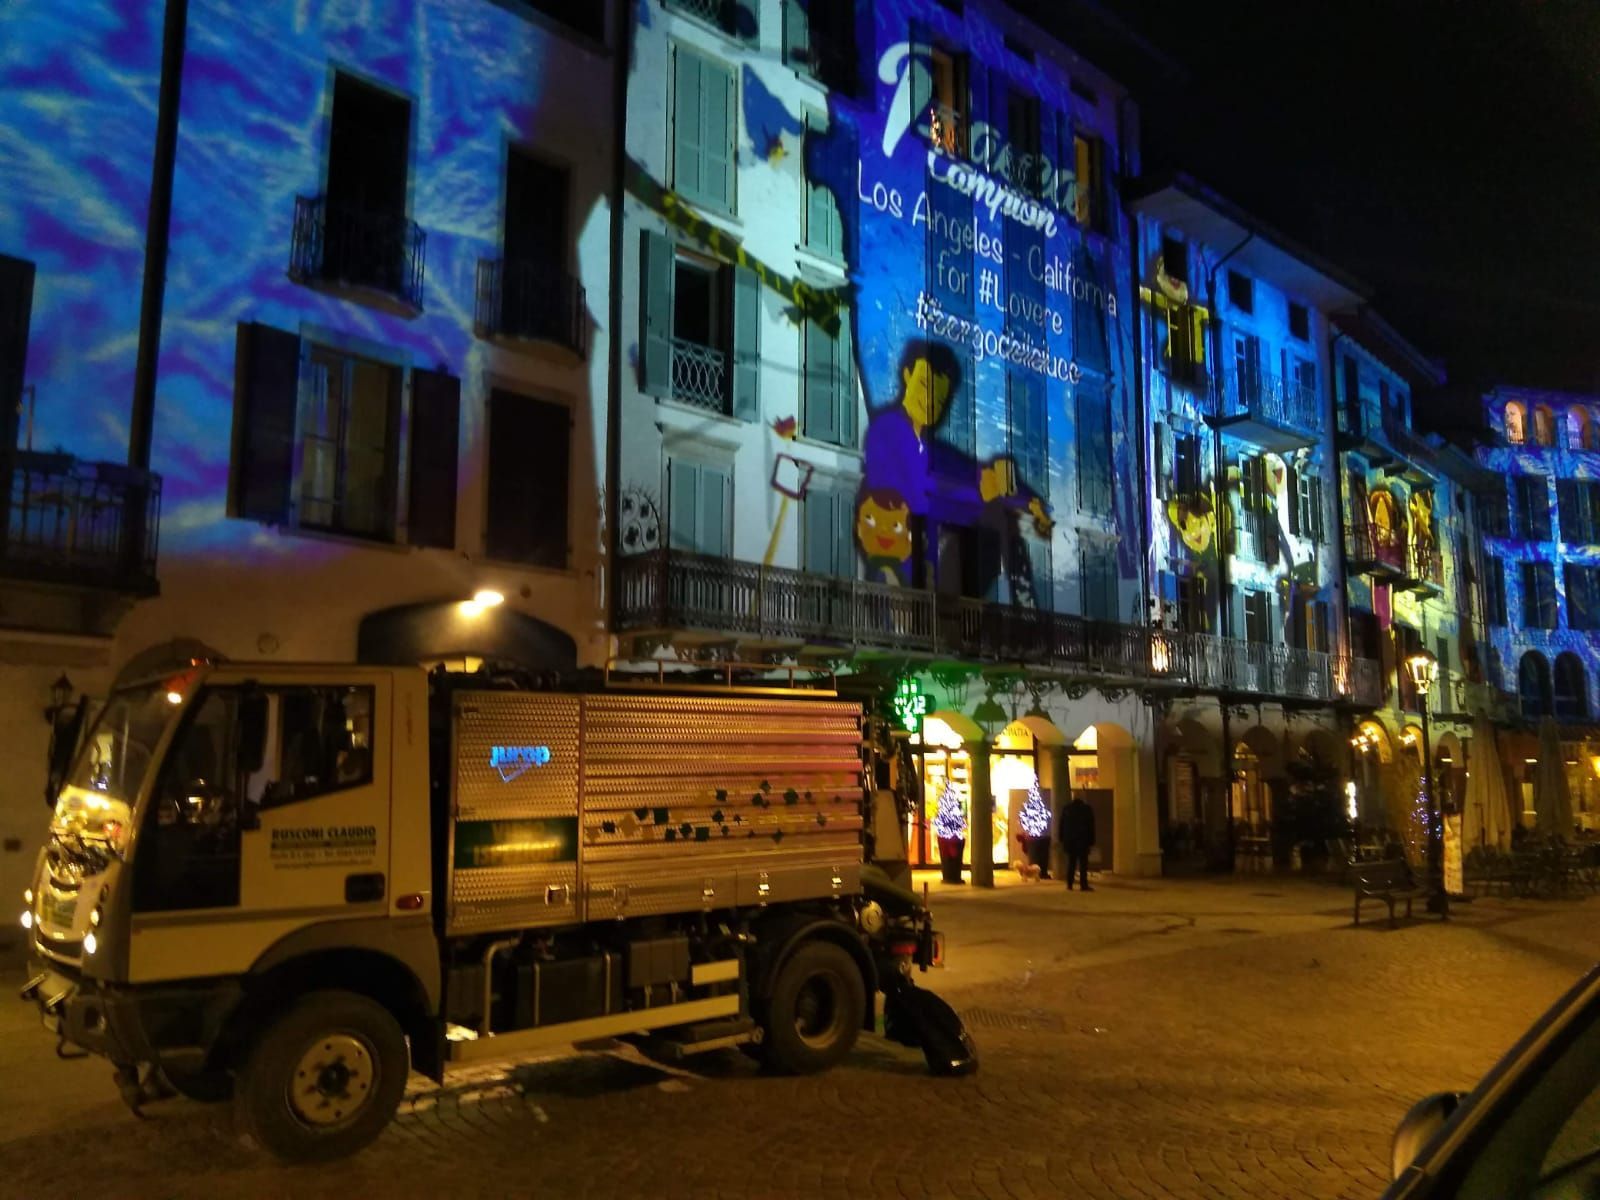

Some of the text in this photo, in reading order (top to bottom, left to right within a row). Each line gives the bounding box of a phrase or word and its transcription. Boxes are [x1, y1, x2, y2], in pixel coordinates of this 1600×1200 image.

[857, 159, 903, 218] Los
[912, 191, 1003, 264] Angeles
[1028, 245, 1117, 317] California
[936, 251, 1063, 334] for #Lovere
[271, 825, 376, 841] RUSCONI CLAUDIO
